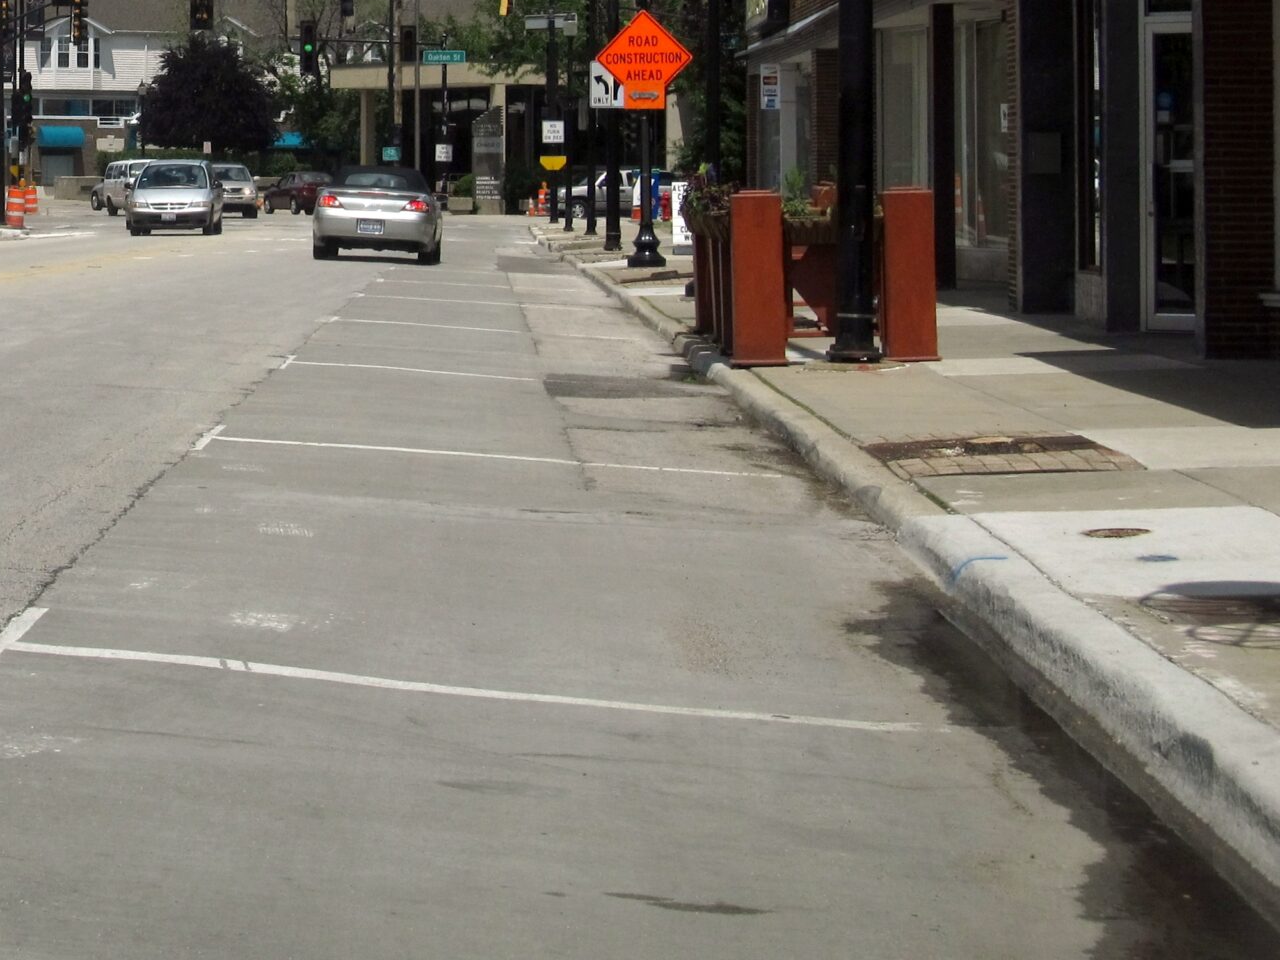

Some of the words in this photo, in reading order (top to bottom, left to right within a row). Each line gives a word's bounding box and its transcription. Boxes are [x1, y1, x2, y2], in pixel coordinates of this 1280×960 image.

[628, 35, 659, 47] ROAD
[605, 52, 682, 65] CONSTRUCTION
[626, 69, 663, 81] AHEAD
